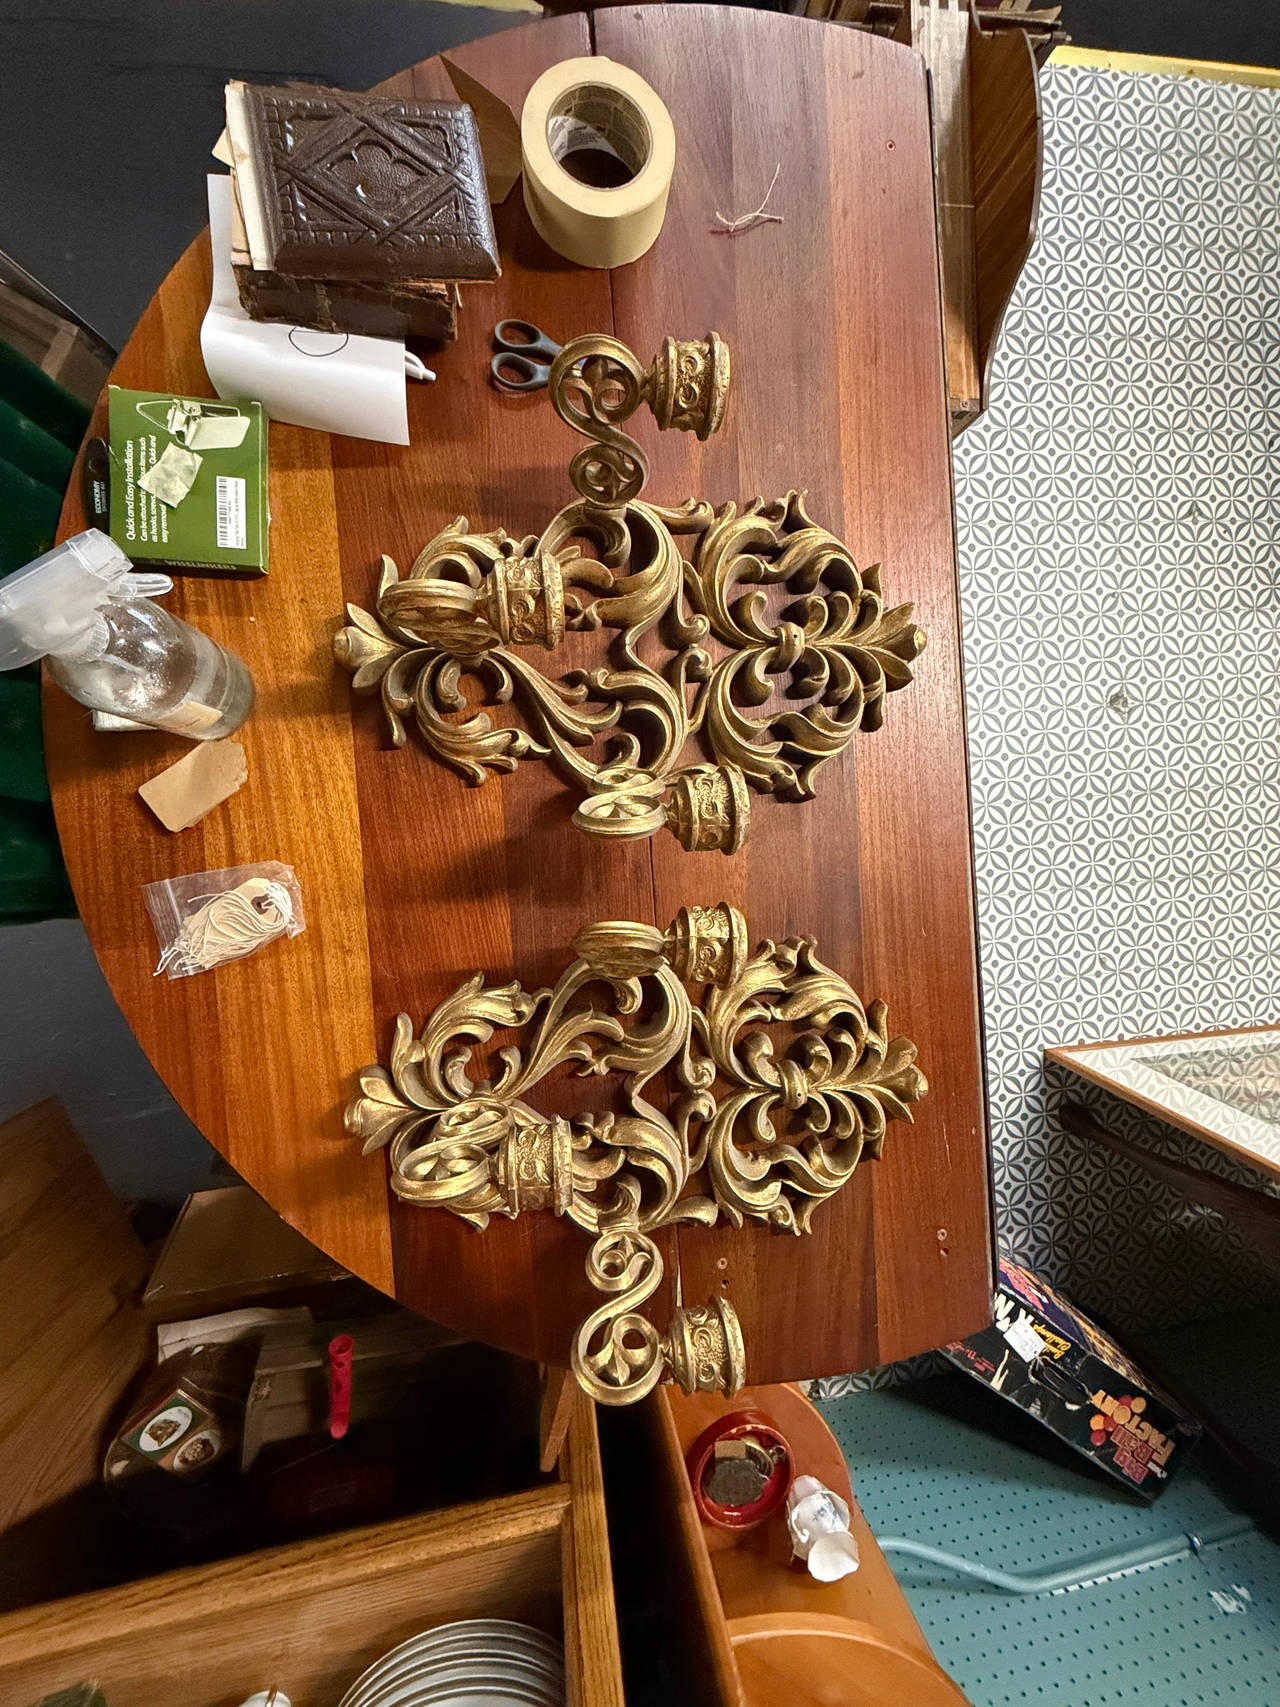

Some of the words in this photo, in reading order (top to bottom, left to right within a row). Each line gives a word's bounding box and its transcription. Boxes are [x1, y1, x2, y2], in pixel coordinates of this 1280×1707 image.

[138, 437, 146, 451] such
[148, 434, 156, 447] and
[124, 440, 134, 483] Installation
[138, 451, 146, 466] items
[148, 447, 158, 464] Quick
[94, 480, 102, 514] ECONOMY
[125, 482, 136, 501] Easy
[125, 500, 135, 518] and
[138, 495, 147, 521] attached
[158, 503, 168, 529] removal
[126, 517, 136, 541] Quick
[139, 521, 147, 529] be
[140, 528, 148, 542] Can
[150, 534, 158, 543] as
[160, 528, 169, 543] easy
[1090, 1388, 1176, 1466] FACTORY
